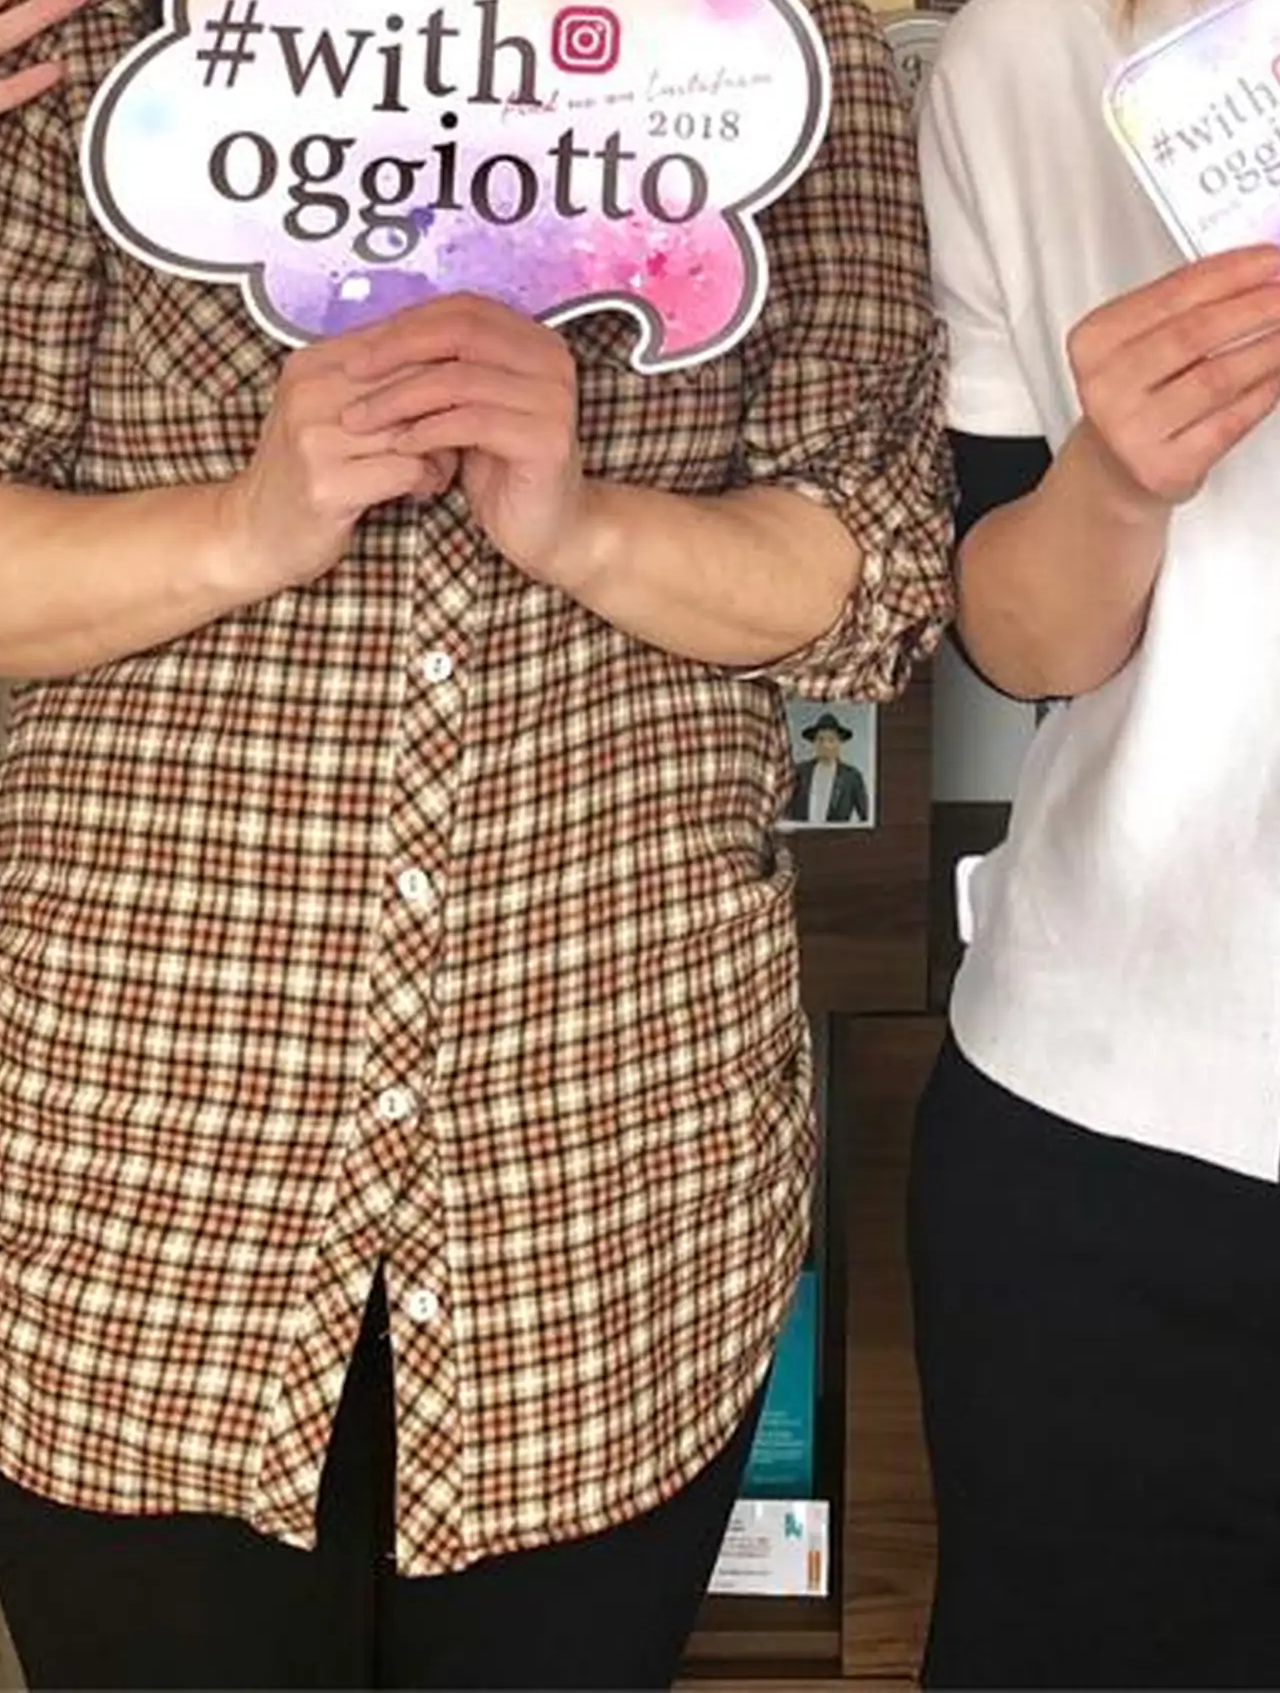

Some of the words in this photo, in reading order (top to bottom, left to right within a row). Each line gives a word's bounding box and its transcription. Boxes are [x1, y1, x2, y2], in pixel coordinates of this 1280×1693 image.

[648, 110, 741, 140] 2018
[1151, 78, 1278, 168] #with
[208, 110, 710, 263] oggiotto
